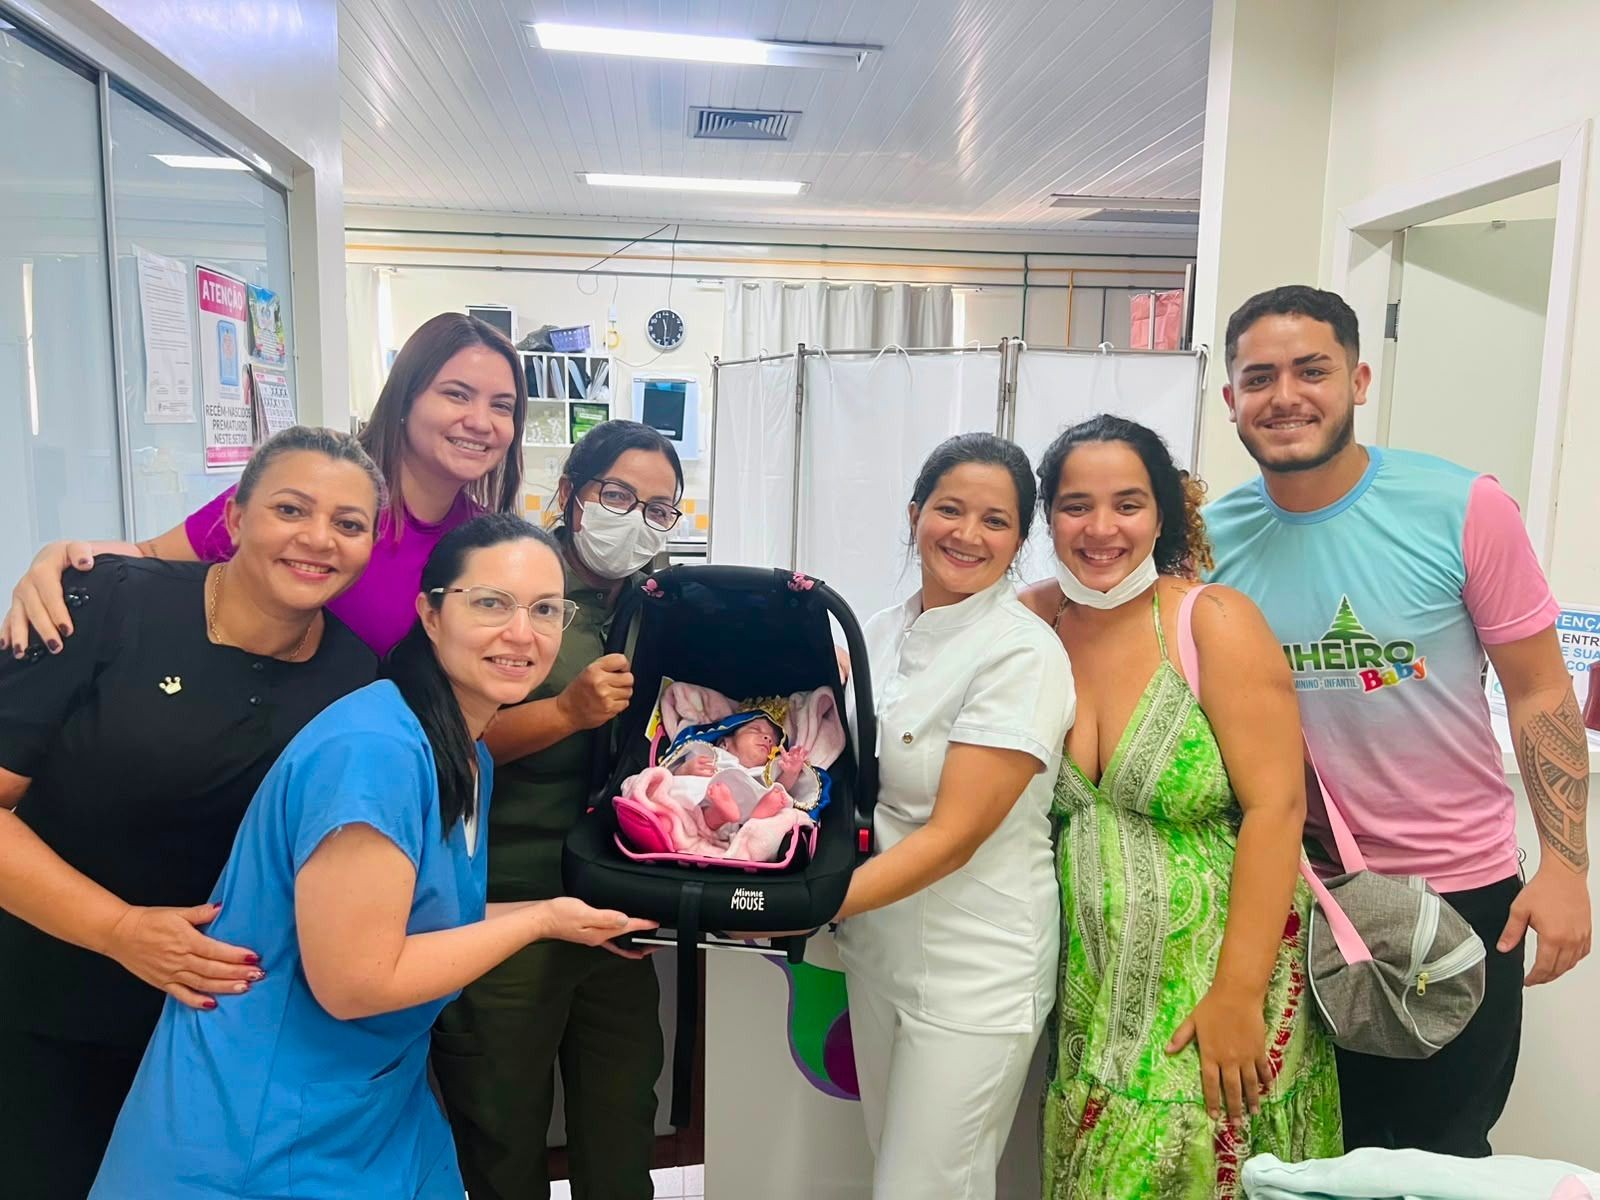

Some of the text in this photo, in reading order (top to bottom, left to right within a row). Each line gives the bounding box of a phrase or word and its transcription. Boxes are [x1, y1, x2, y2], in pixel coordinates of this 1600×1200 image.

[202, 279, 243, 313] ATENÇÃO
[212, 419, 248, 432] PREMATUROS
[214, 433, 247, 445] NESTE SETOR
[1558, 614, 1600, 632] ENÇ
[1358, 656, 1427, 693] Baby
[1324, 678, 1358, 689] INFANTIL
[734, 887, 764, 898] Minnie
[730, 896, 765, 911] MOUSE
